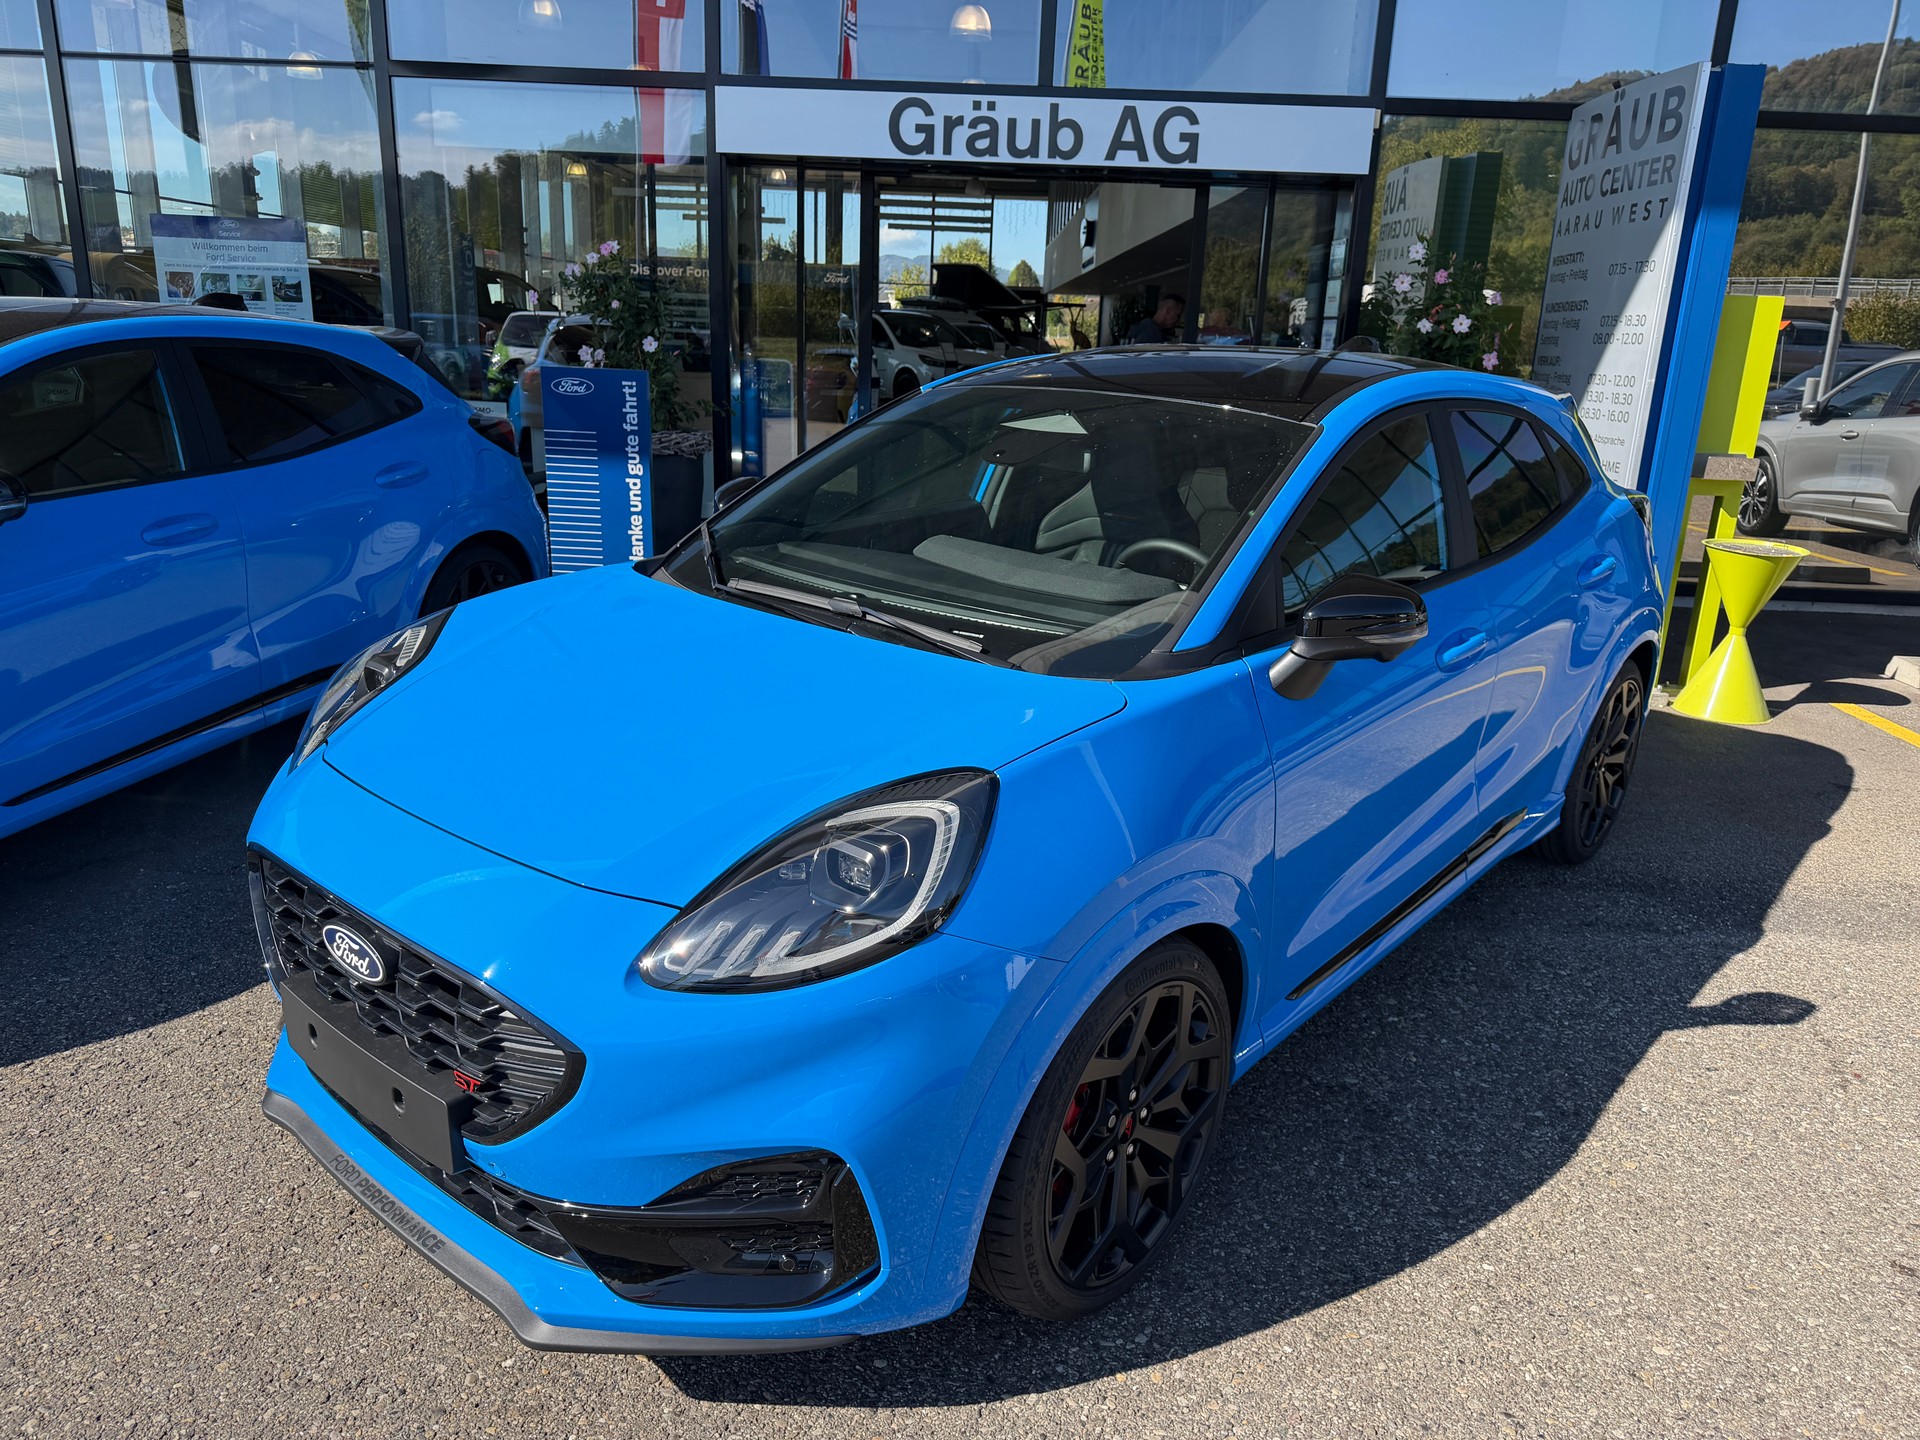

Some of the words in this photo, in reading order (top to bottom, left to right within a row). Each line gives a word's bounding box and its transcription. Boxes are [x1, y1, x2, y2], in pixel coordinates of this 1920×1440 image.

[888, 97, 1084, 160] Gräub
[1103, 105, 1200, 165] AG
[1568, 85, 1687, 171] GRÄUB
[1560, 172, 1597, 209] AUTO
[1600, 153, 1677, 198] CENTER
[1555, 208, 1604, 239] AARAU
[1611, 197, 1669, 226] WEST
[219, 230, 241, 238] Service
[191, 241, 246, 252] Willkommen
[247, 243, 269, 253] beim
[206, 252, 225, 261] Ford
[227, 253, 257, 263] Service
[630, 263, 686, 277] Disover
[1635, 260, 1656, 274] 17.30
[823, 272, 850, 284] Ford
[1624, 314, 1647, 327] 18.30
[1592, 333, 1615, 345] 08.00
[1621, 333, 1644, 345] 12.00
[556, 378, 590, 394] Ford
[1587, 373, 1607, 386] 07.30
[1613, 374, 1636, 388] 12.00
[1586, 390, 1604, 403] 13.30
[1611, 392, 1633, 405] 18.30
[622, 380, 638, 432] fahrt!
[1580, 407, 1601, 420] 08.30
[1608, 409, 1630, 423] 16.00
[625, 435, 644, 476] gute
[625, 478, 643, 512] und
[331, 929, 373, 977] Ford
[1125, 955, 1177, 998] Continental
[453, 1069, 481, 1093] ST
[329, 1153, 361, 1183] FORD
[353, 1176, 447, 1254] PERFORMANCE
